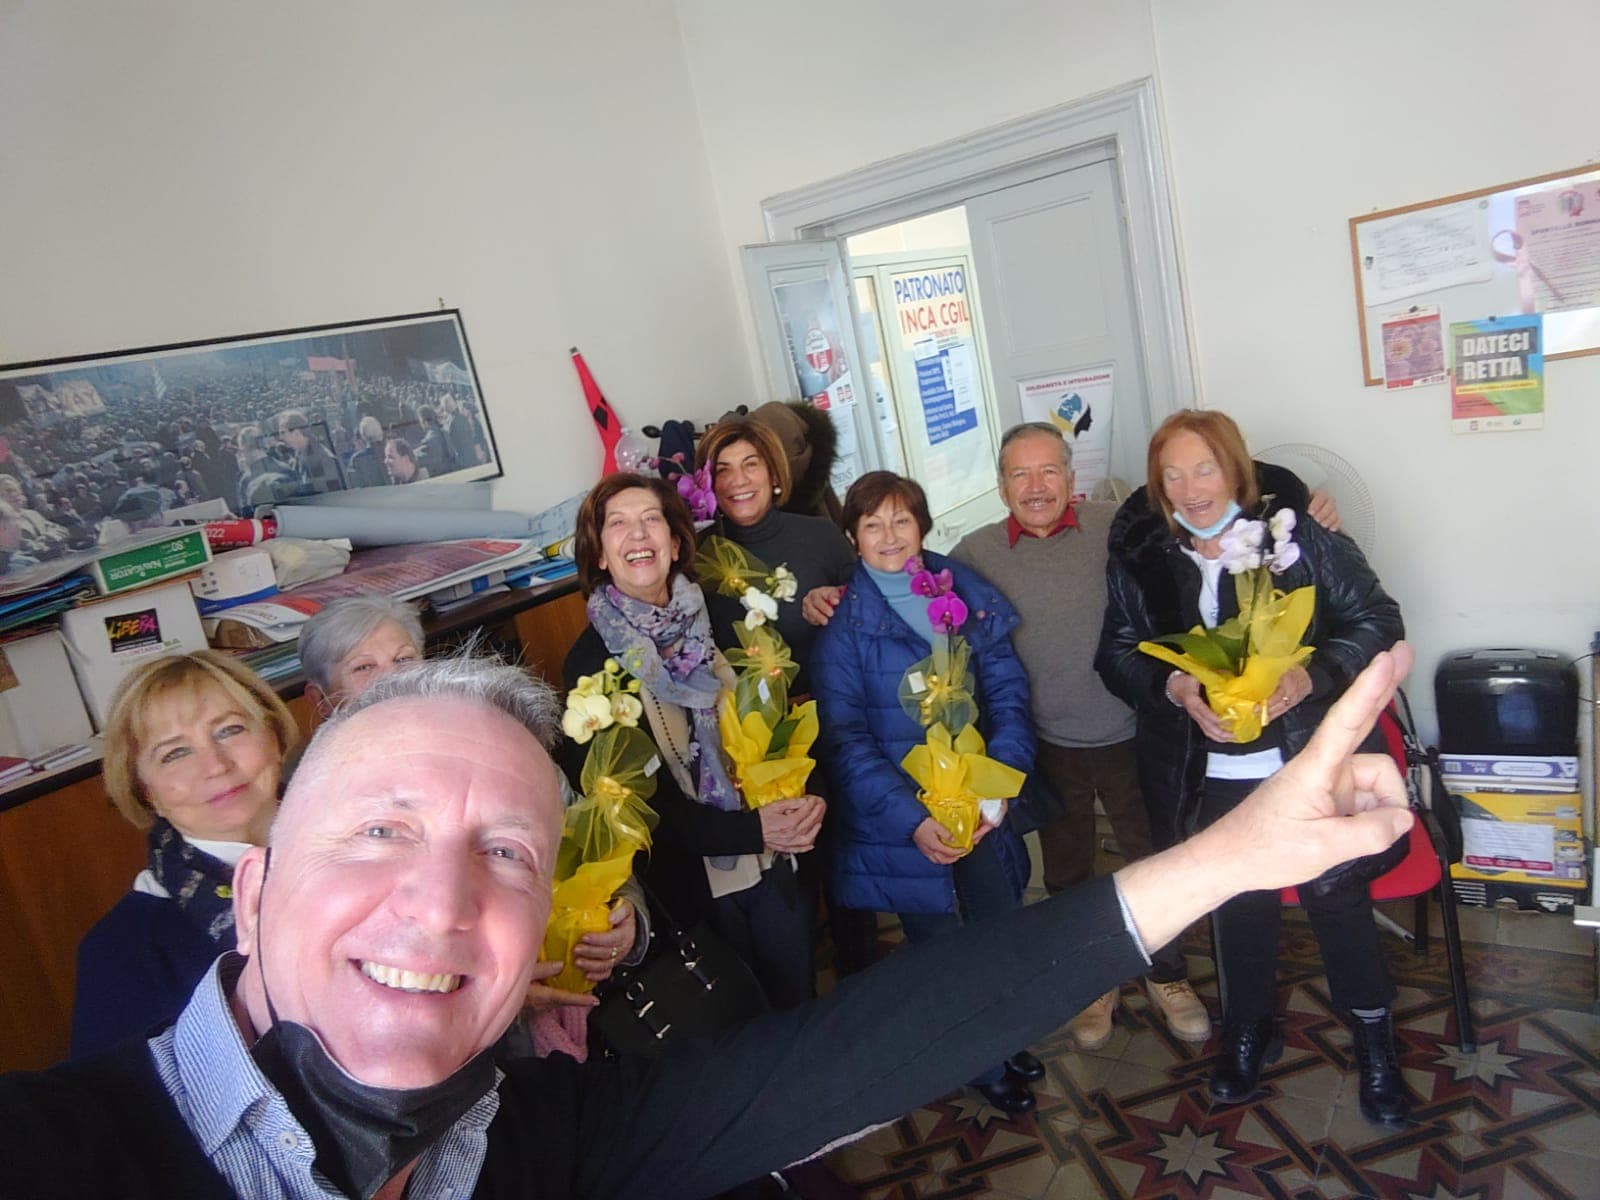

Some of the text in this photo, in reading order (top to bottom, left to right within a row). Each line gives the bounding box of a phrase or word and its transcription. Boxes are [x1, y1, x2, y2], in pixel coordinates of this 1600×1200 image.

[894, 270, 965, 304] PATRONATO
[900, 300, 969, 335] INCA CGIL
[1462, 332, 1530, 357] DATECI
[1462, 356, 1523, 381] RETTA
[206, 528, 225, 538] 022
[109, 559, 162, 580] NAVIGATOR
